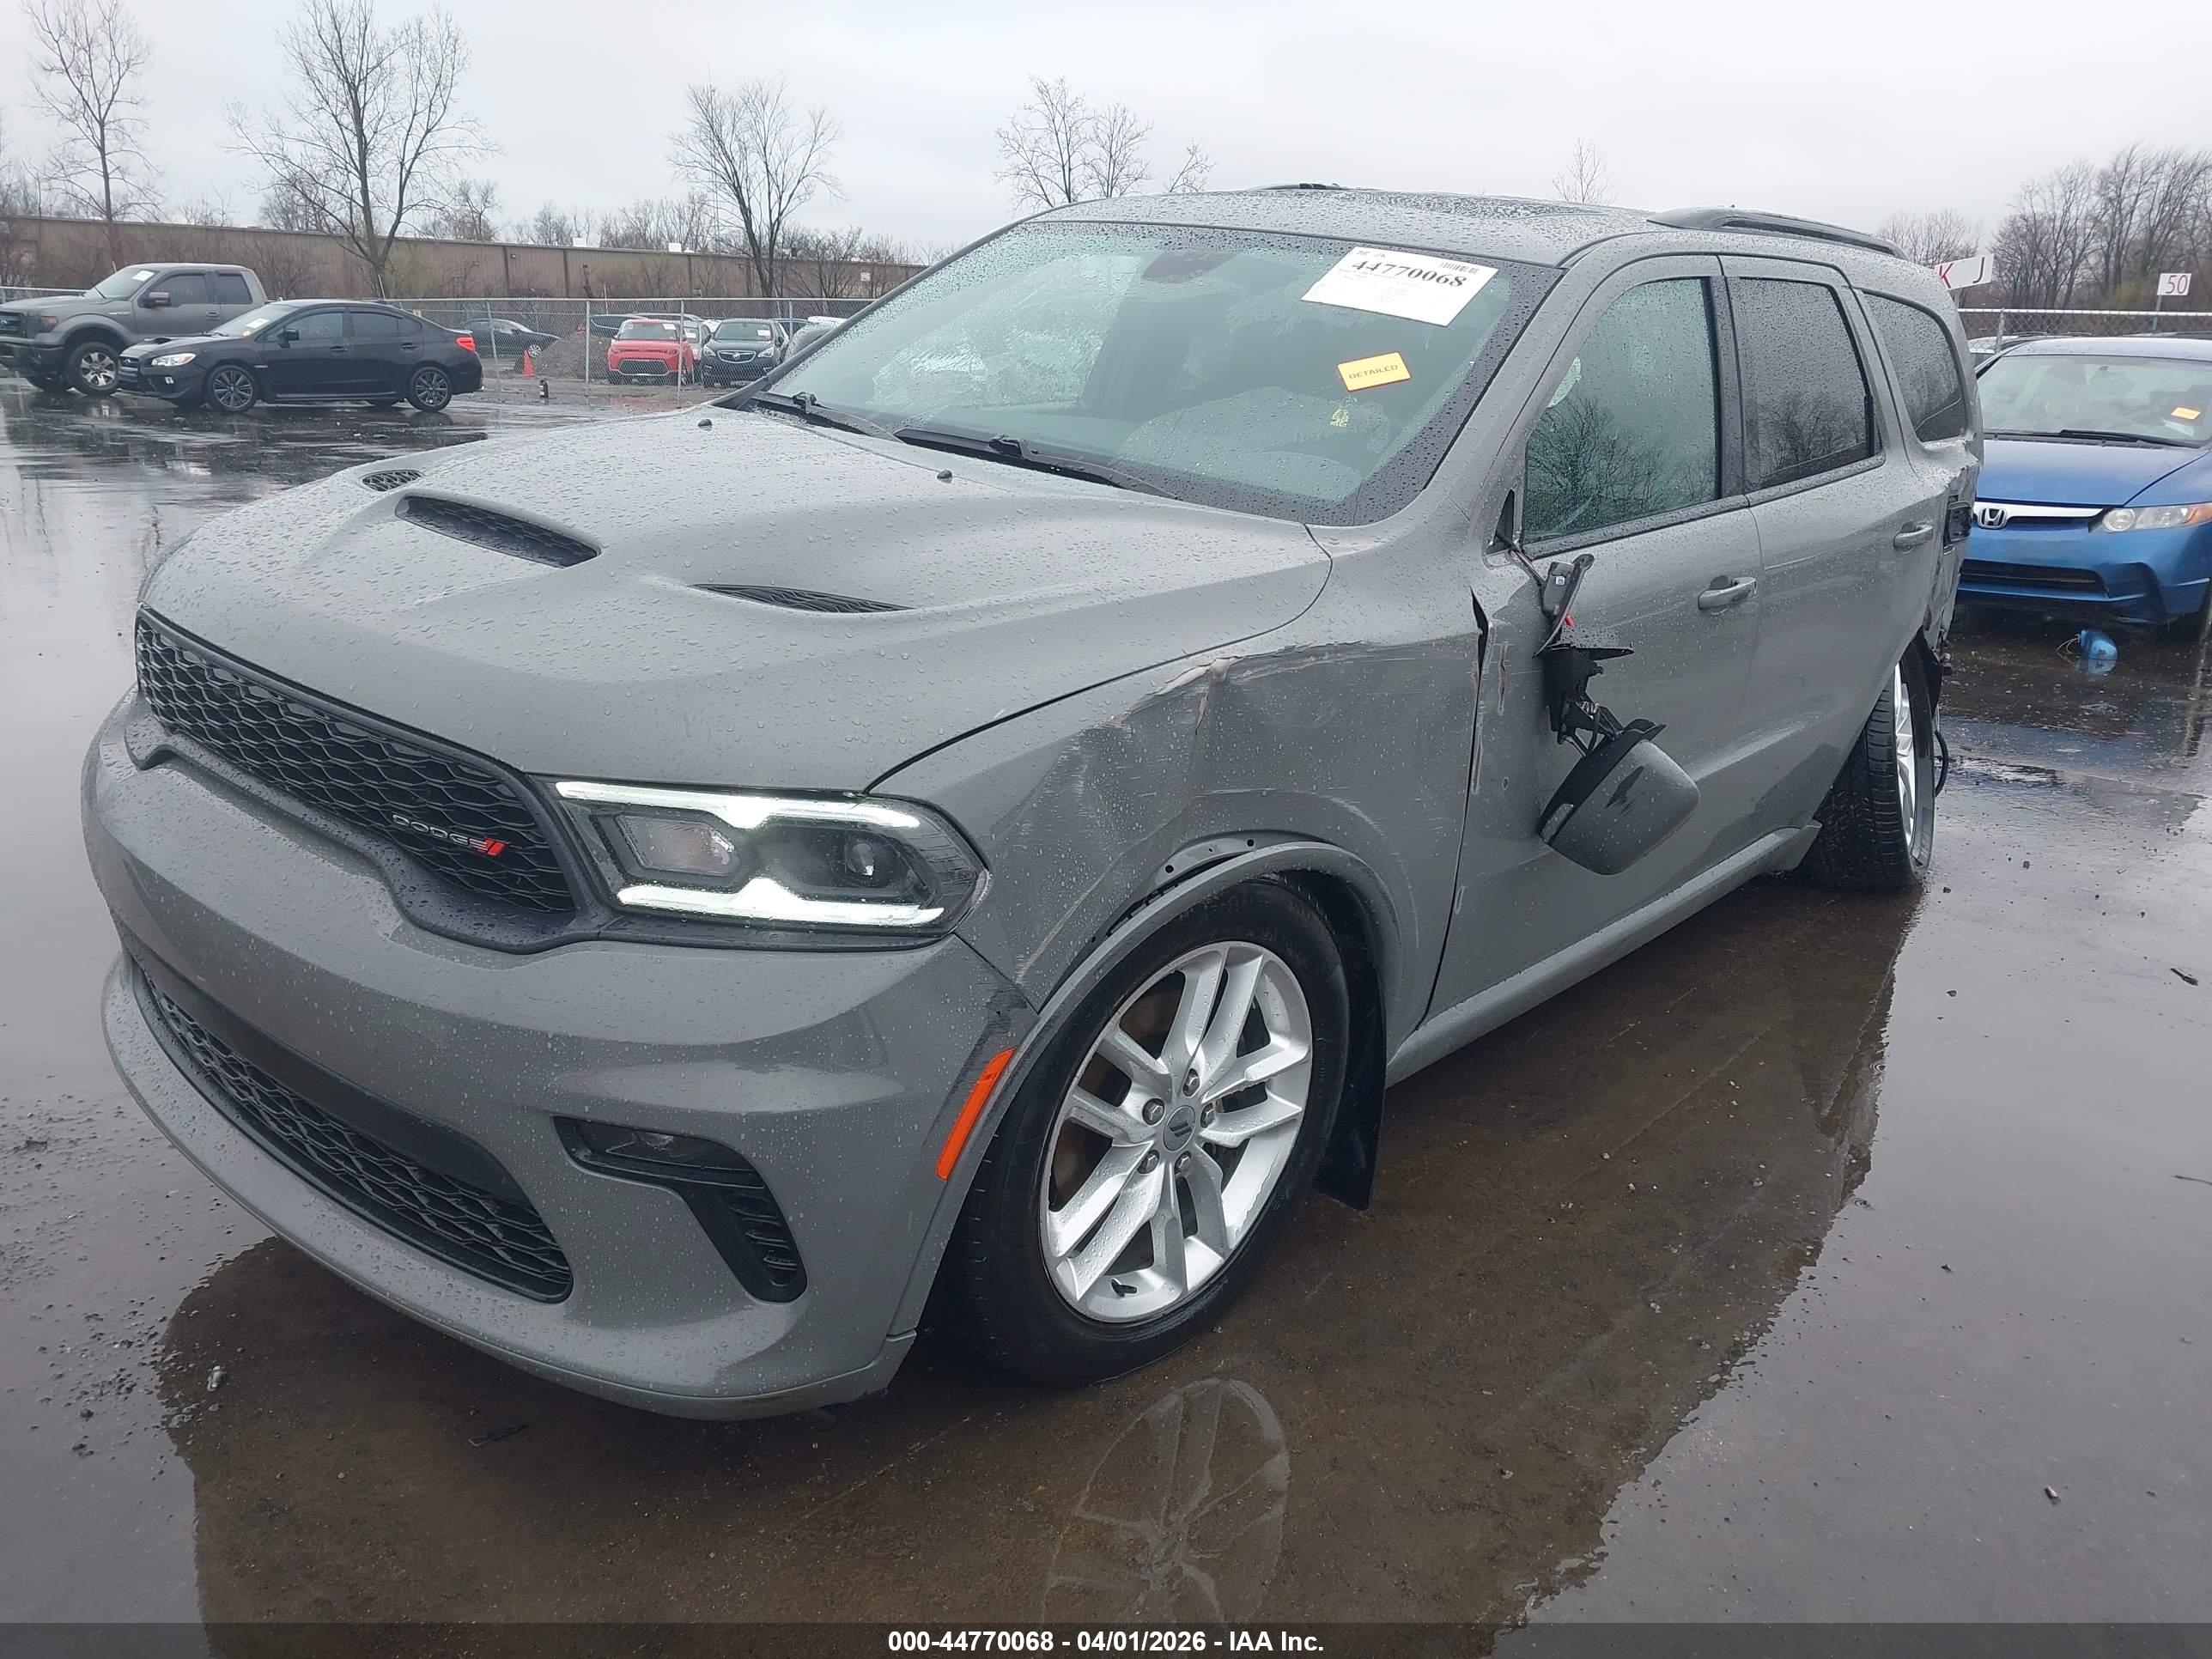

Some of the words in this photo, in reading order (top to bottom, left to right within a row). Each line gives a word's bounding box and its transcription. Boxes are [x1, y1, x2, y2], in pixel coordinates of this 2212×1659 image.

[1352, 260, 1468, 288] 44770068
[1939, 263, 1954, 289] K
[1972, 257, 1985, 283] J
[2165, 274, 2188, 295] 50
[1348, 364, 1398, 379] DETAILED
[392, 813, 489, 852] DODGE
